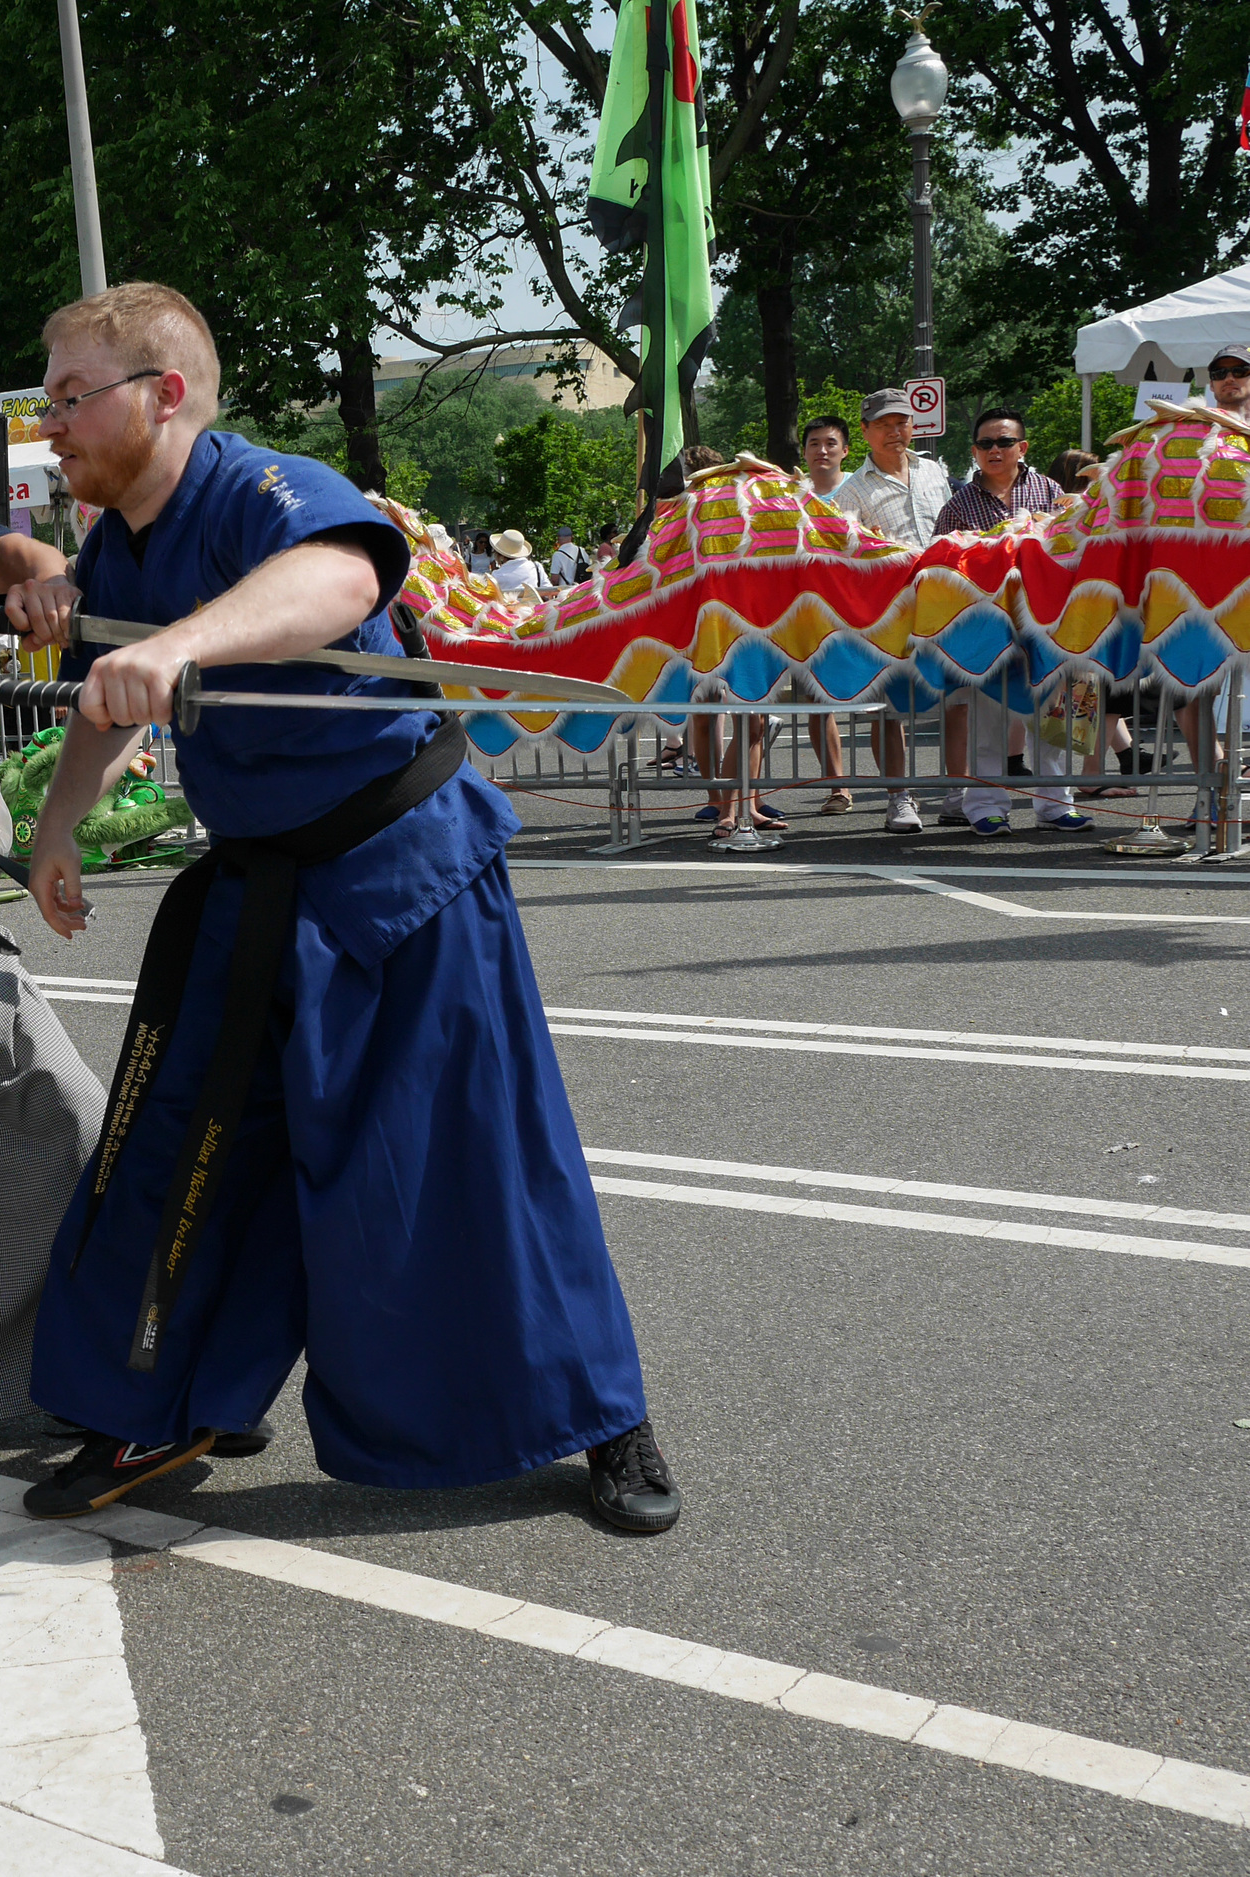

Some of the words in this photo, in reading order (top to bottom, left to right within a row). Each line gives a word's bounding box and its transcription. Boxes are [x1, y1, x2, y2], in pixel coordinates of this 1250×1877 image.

[918, 392, 931, 408] P
[1152, 393, 1174, 401] HALAL
[182, 1165, 209, 1217] Michael
